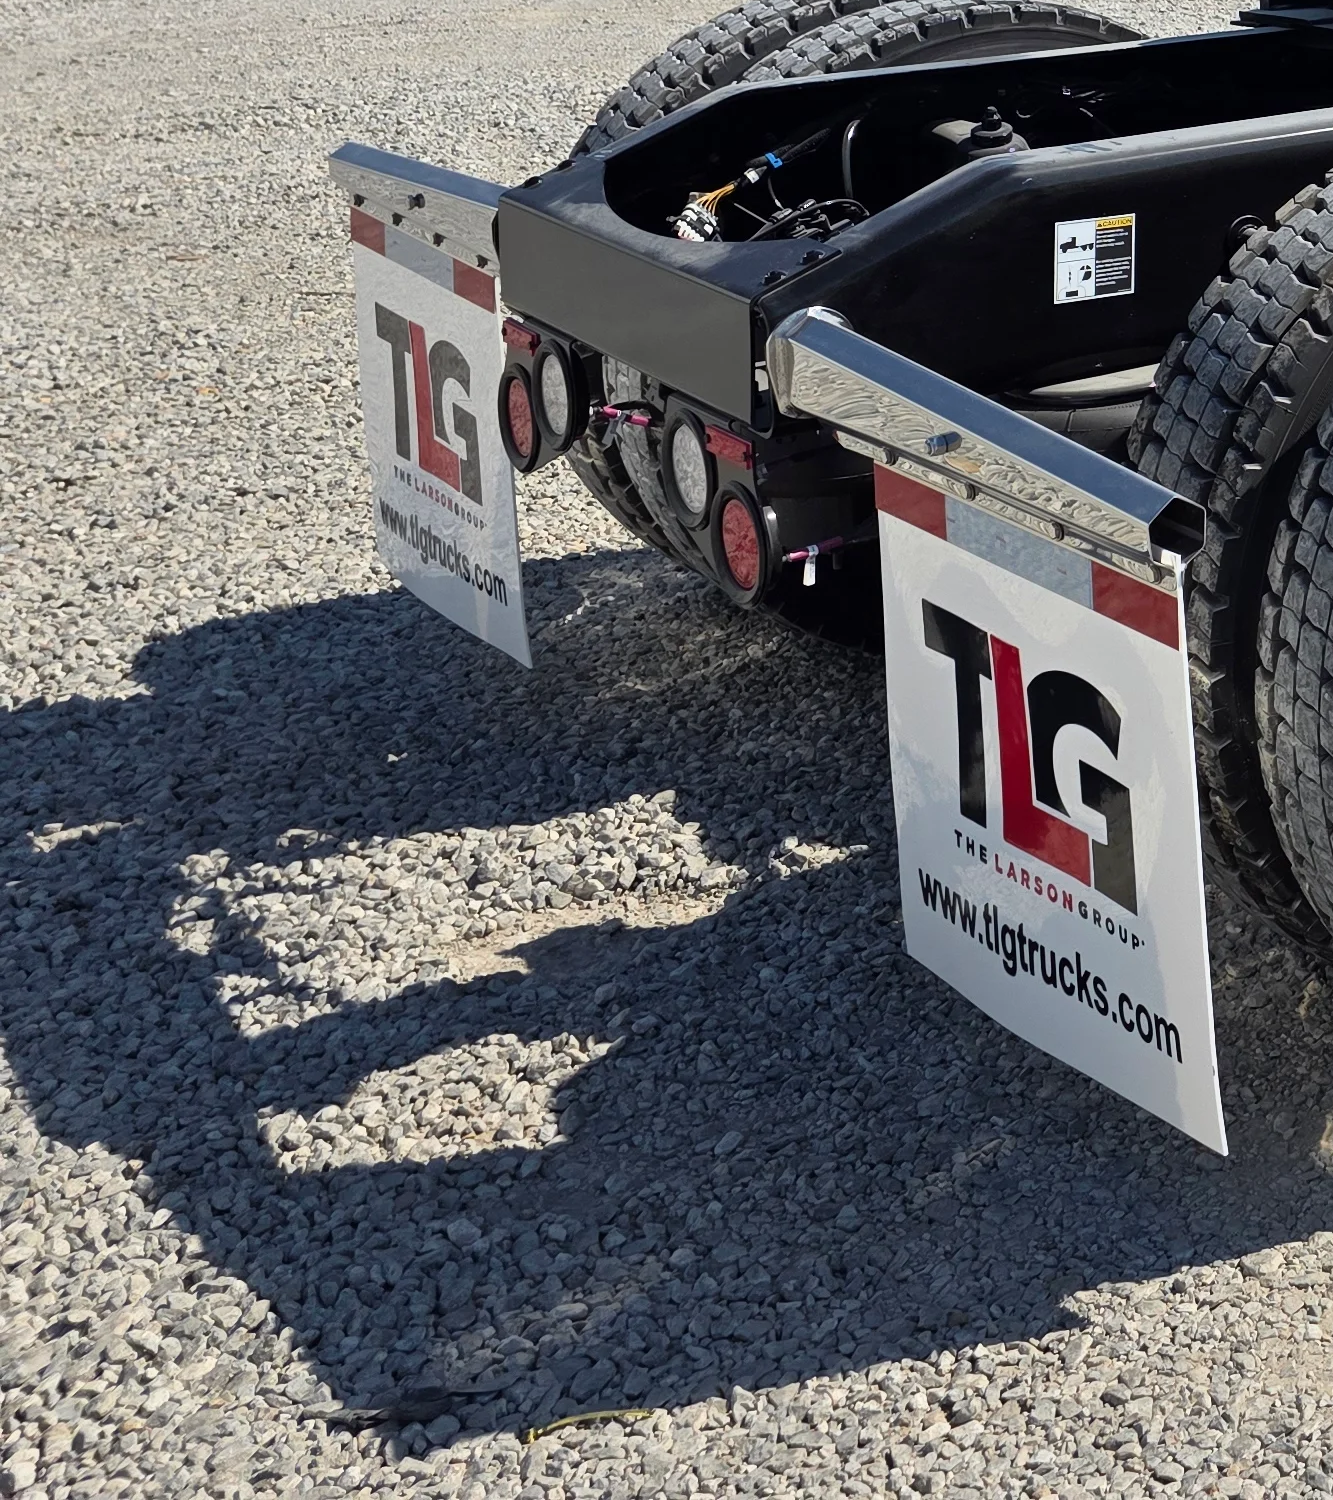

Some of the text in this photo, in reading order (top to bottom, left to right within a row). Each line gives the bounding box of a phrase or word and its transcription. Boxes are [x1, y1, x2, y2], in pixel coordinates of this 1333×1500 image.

[1103, 219, 1132, 227] CAUTION
[375, 301, 484, 507] TLG
[379, 497, 508, 607] www.tlgtrucks.com
[922, 598, 1138, 917] TLG
[954, 829, 988, 864] THE
[994, 853, 1073, 922] LARSON
[918, 867, 1183, 1064] www.tlgtrucks.com
